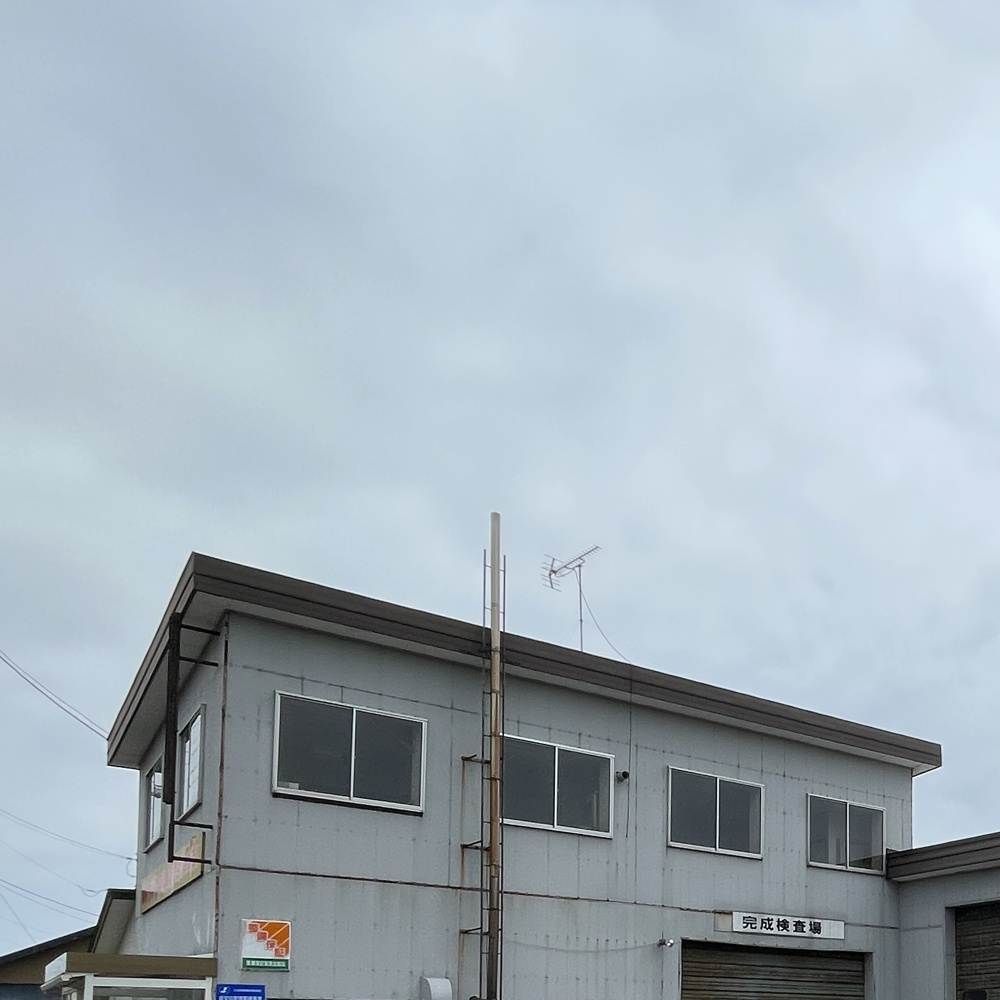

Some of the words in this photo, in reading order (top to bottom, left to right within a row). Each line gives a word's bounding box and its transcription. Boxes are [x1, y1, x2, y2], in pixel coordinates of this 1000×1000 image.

[742, 915, 823, 935] 完成検査場
